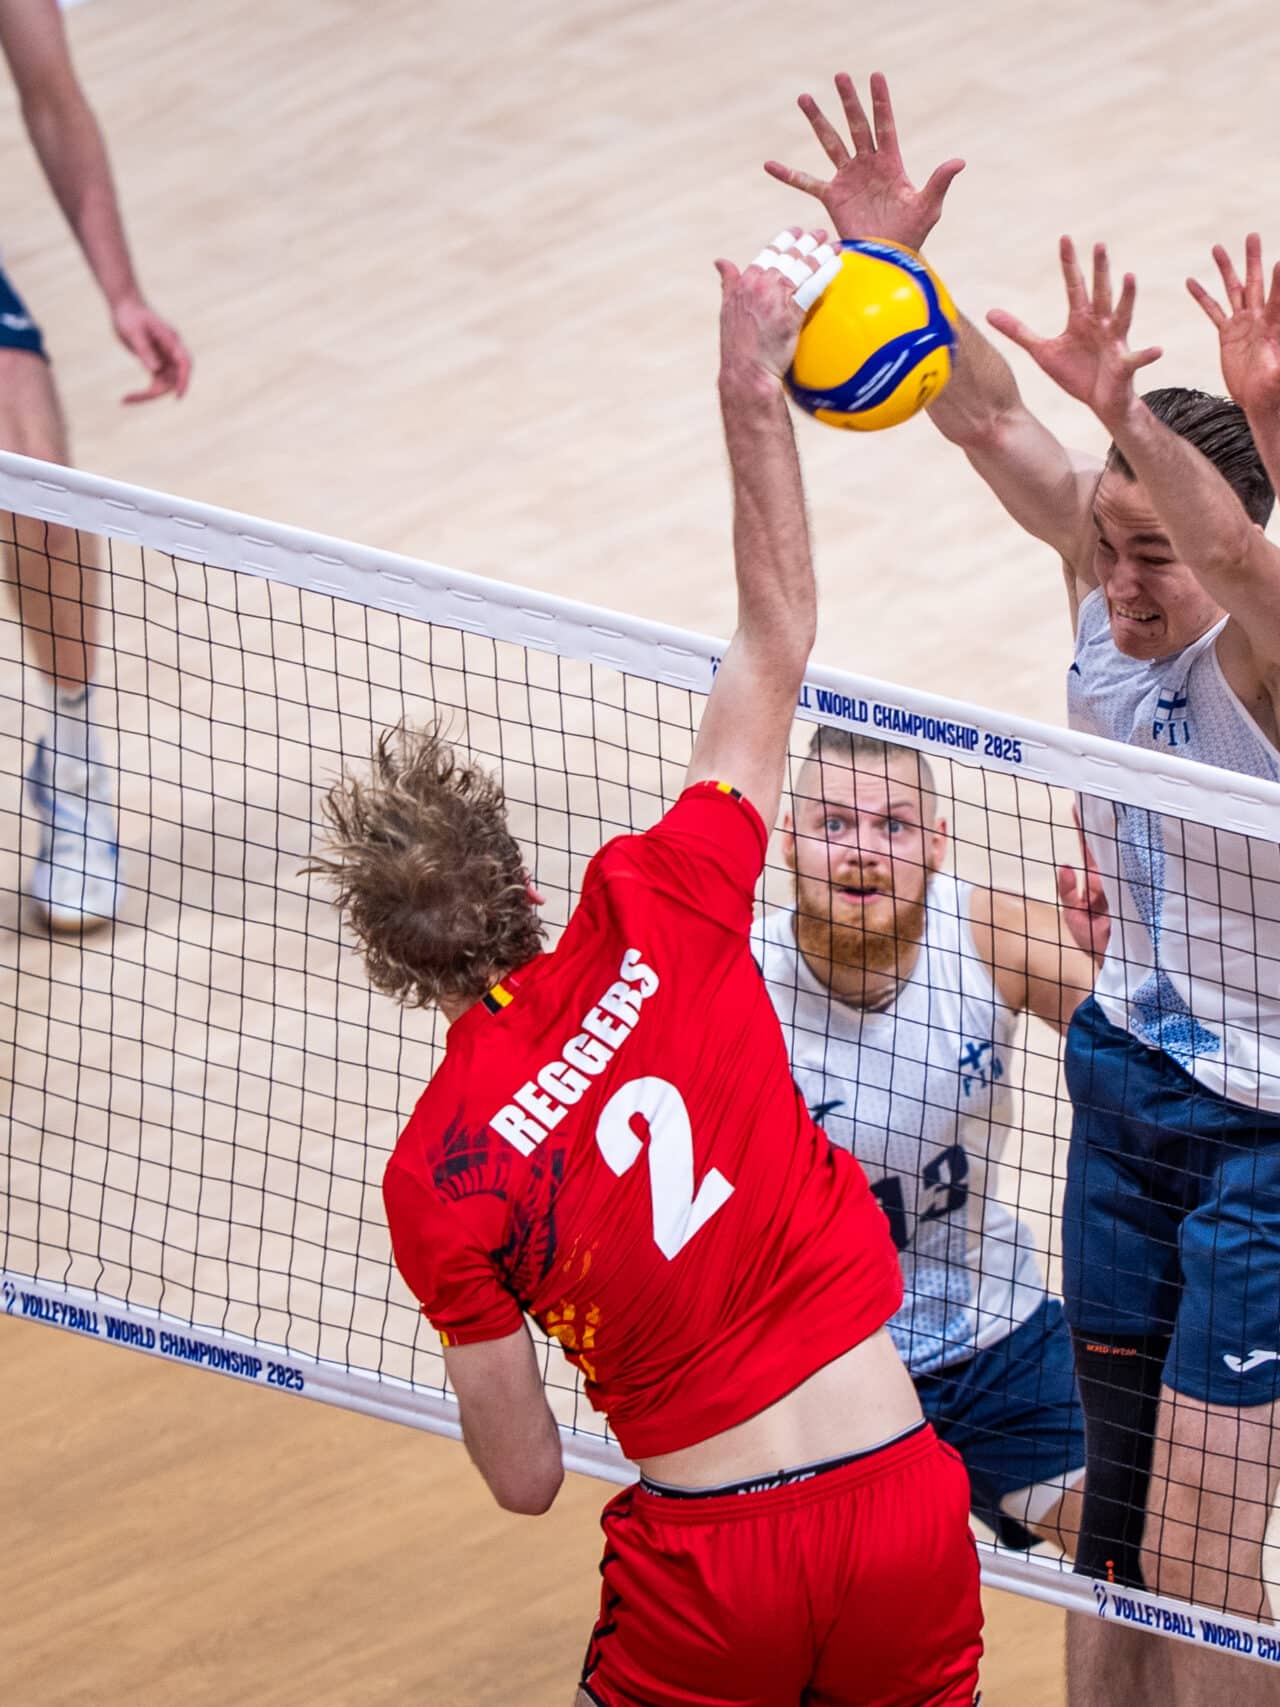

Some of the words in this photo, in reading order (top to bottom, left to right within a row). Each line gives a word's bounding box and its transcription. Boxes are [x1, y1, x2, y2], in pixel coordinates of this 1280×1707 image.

[816, 689, 868, 723] WORLD
[873, 704, 979, 751] CHAMPIONSHIP
[489, 948, 660, 1157] REGGERS
[596, 1076, 735, 1261] 2
[21, 1292, 100, 1334] VOLLEYBALL
[104, 1315, 156, 1349] WORLD
[160, 1331, 262, 1378] CHAMPIONSHIP
[1112, 1595, 1196, 1639] VOLLEYBALL
[1200, 1619, 1254, 1654] WORLD
